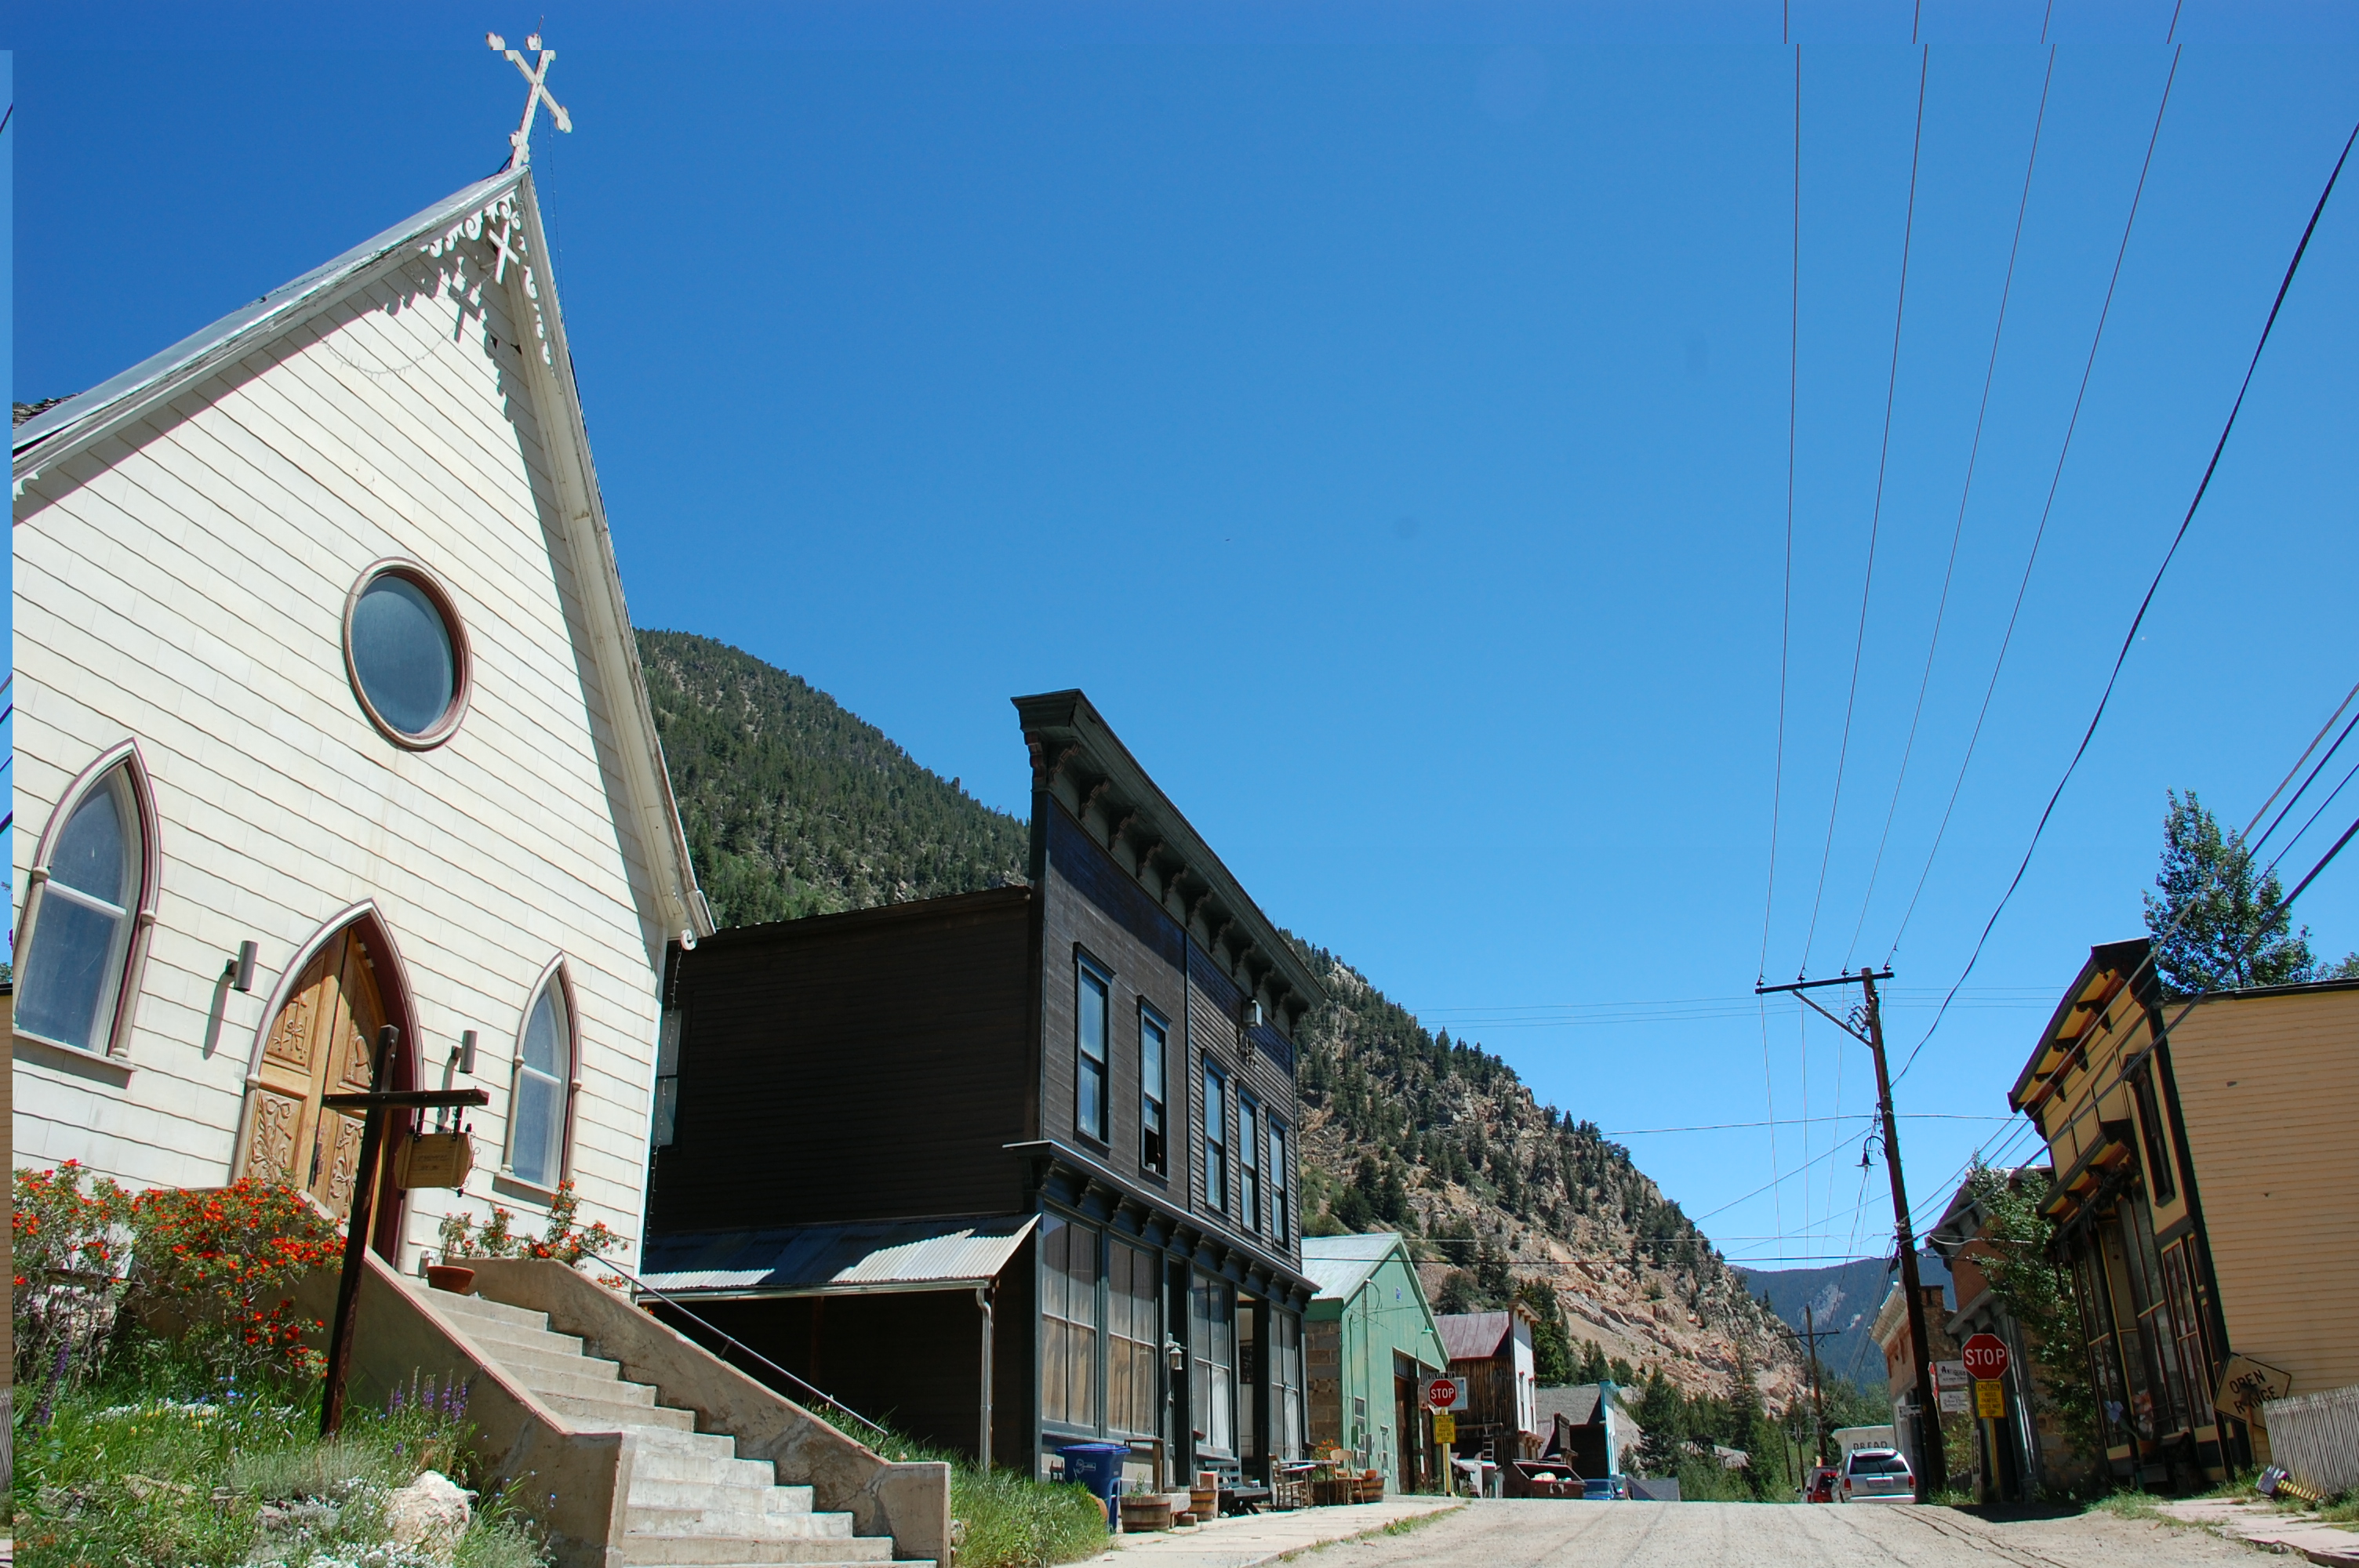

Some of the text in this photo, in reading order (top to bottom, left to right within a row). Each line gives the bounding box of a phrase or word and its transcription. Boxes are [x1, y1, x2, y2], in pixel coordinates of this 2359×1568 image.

[1965, 1348, 2005, 1366] STOP
[2229, 1369, 2266, 1394] OPEN
[1430, 1388, 1455, 1399] STOP
